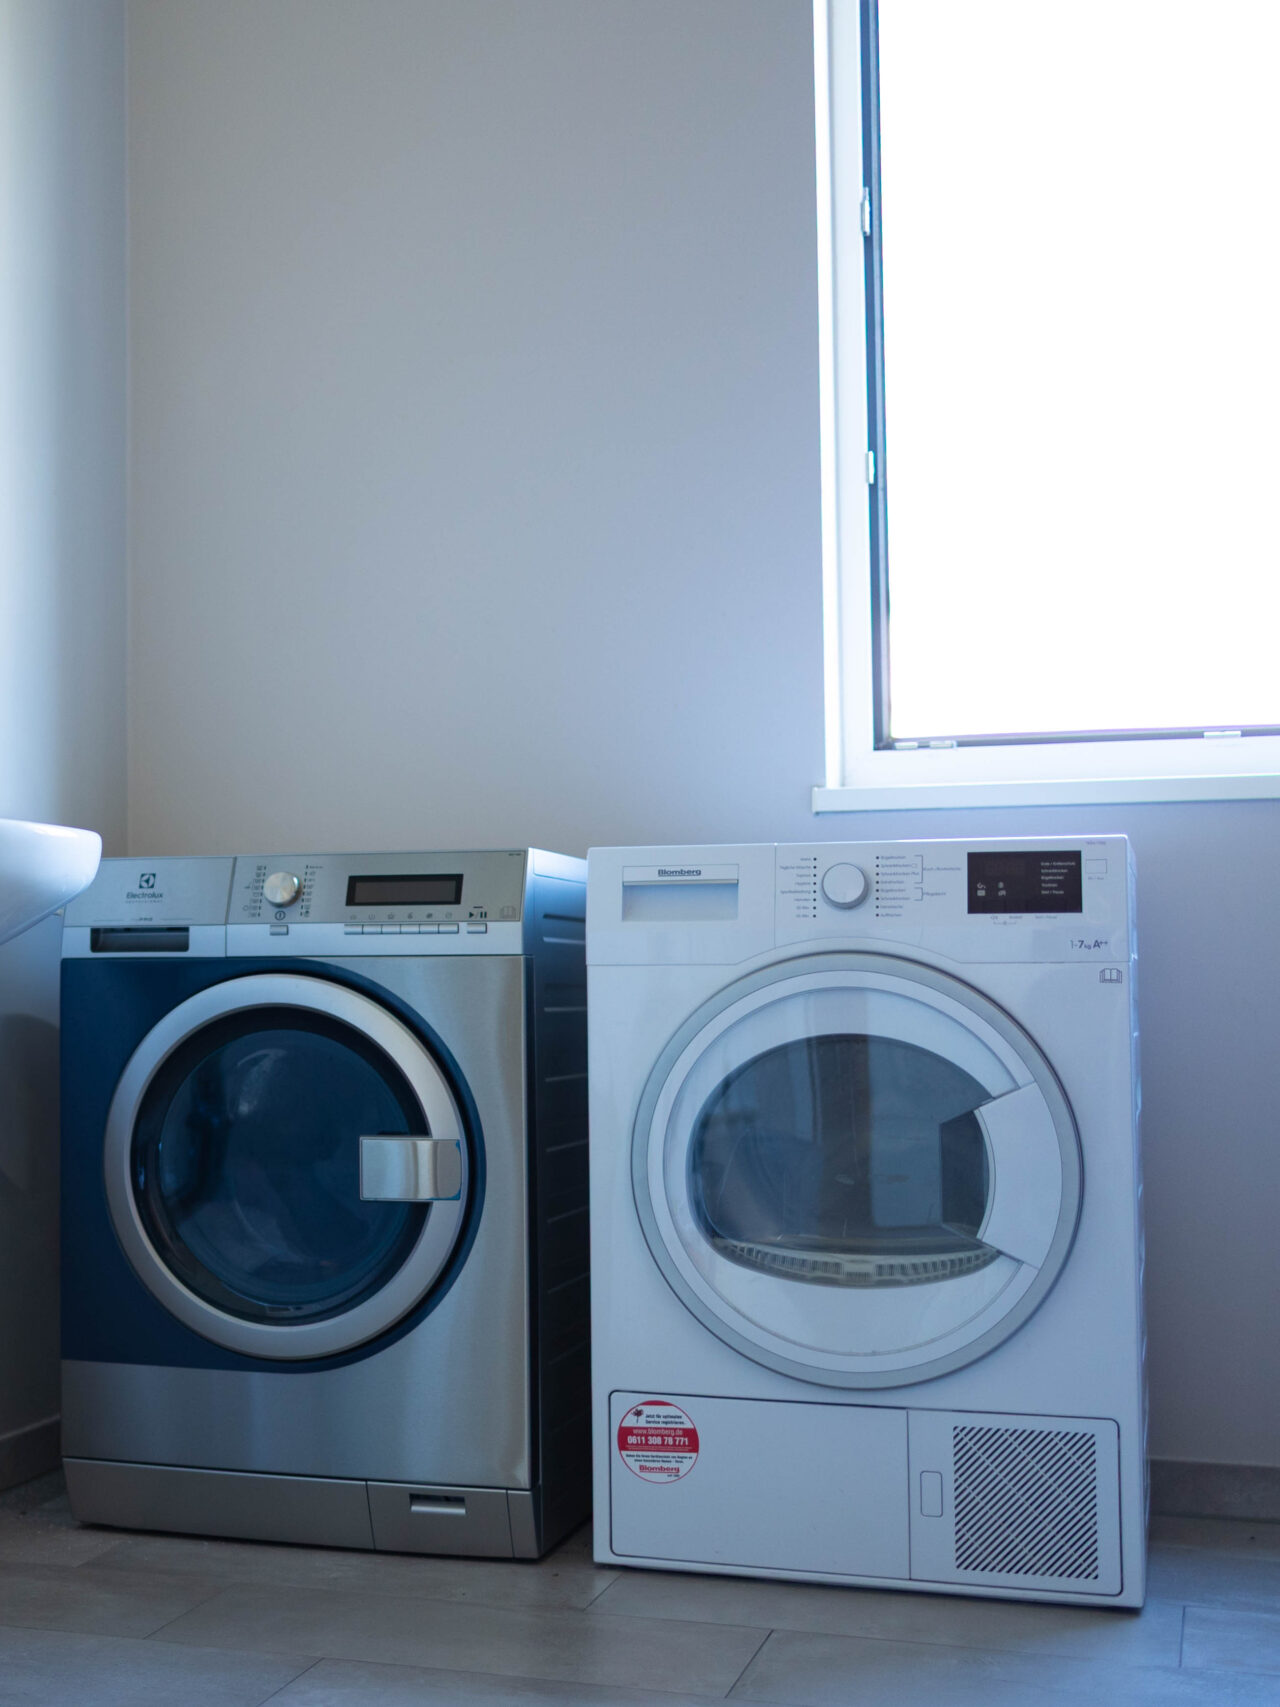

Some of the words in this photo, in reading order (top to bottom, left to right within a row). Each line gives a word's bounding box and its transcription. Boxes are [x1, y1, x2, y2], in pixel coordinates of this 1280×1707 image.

[657, 868, 702, 877] Blomberg
[126, 891, 164, 900] Electrolux
[633, 1428, 683, 1436] www.blomberg.de
[627, 1435, 645, 1445] 0611
[675, 1436, 689, 1446] 771
[639, 1464, 680, 1474] Blomberg
